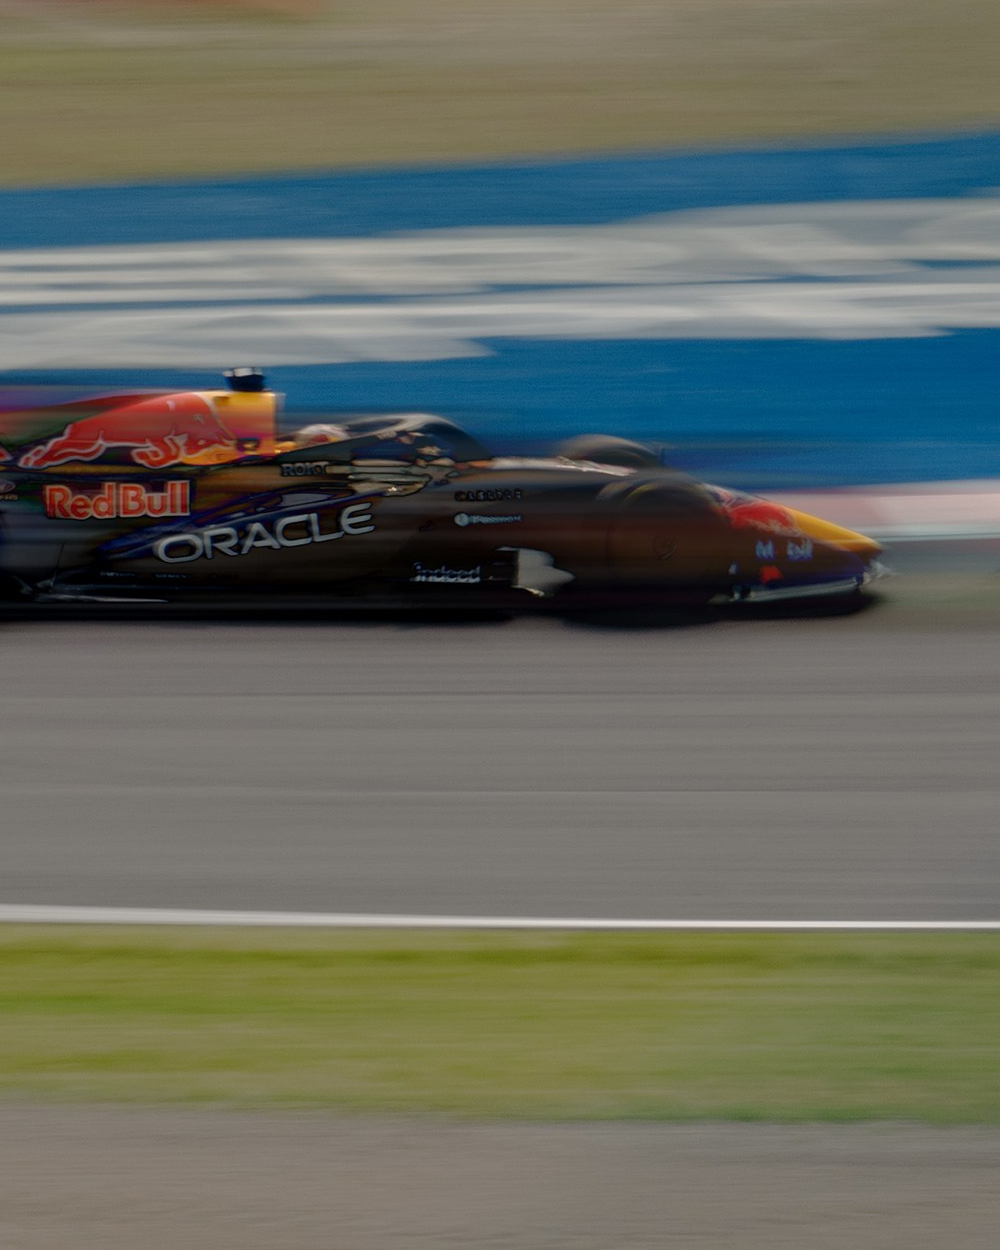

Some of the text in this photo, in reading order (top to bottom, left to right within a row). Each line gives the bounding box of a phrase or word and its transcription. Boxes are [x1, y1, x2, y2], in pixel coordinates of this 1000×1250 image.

[46, 480, 190, 520] Red Bull
[153, 502, 376, 563] ORACLE
